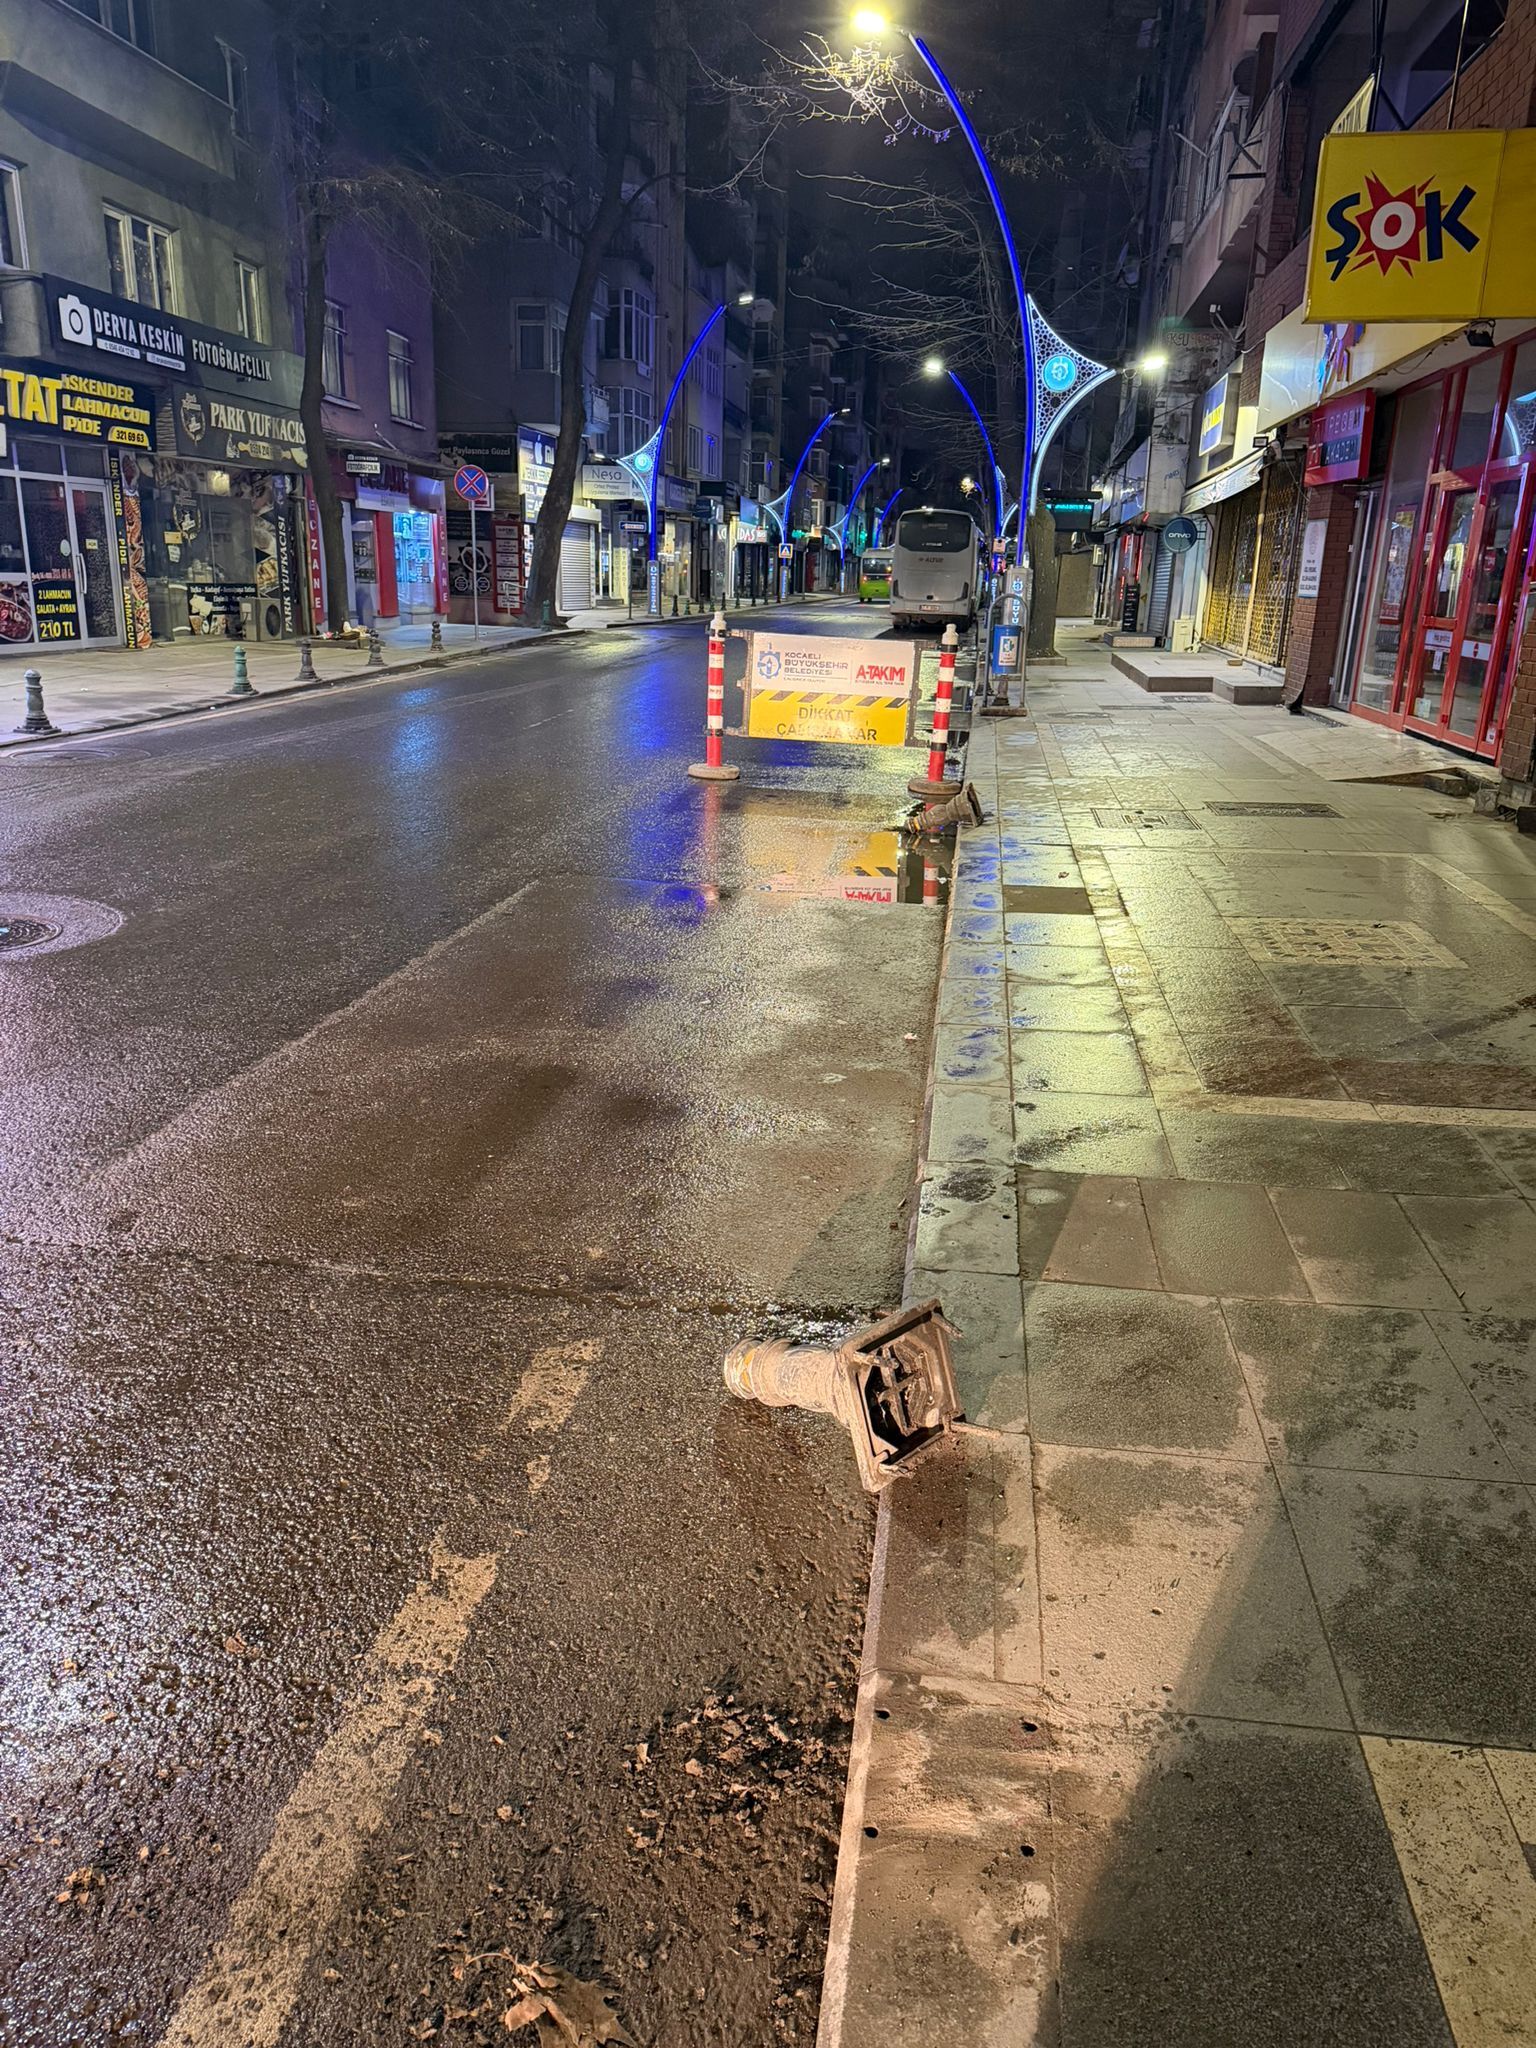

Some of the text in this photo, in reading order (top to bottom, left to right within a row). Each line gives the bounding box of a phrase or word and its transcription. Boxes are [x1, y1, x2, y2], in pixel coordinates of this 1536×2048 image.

[1325, 185, 1481, 282] ŞOK
[93, 308, 185, 357] DERYA KESKİN
[191, 338, 273, 381] FOTOĞRAFÇILIK
[0, 368, 62, 424] TAT
[61, 373, 135, 403] İSKENDER
[62, 394, 150, 425] LAHMACUN
[210, 402, 307, 445] PARK YUFKACIS
[63, 415, 102, 436] PİDE
[116, 430, 145, 443] 321 69 63
[592, 469, 622, 481] Nesa
[308, 500, 322, 609] ECZANE
[439, 515, 449, 602] ECZANE
[278, 515, 294, 634] PARK YUFKACISI
[36, 604, 56, 614] SALATA
[59, 603, 77, 614] AYRAN
[38, 589, 72, 600] 2 LAHMACUN
[40, 621, 75, 639] 210 TL
[123, 586, 137, 650] LAHMACUN
[784, 651, 821, 660] KOCAELİ
[784, 659, 849, 670] BÜYÜKŞEHİR
[784, 667, 833, 676] BELEDİYESİ
[798, 704, 854, 722] DİKKAT
